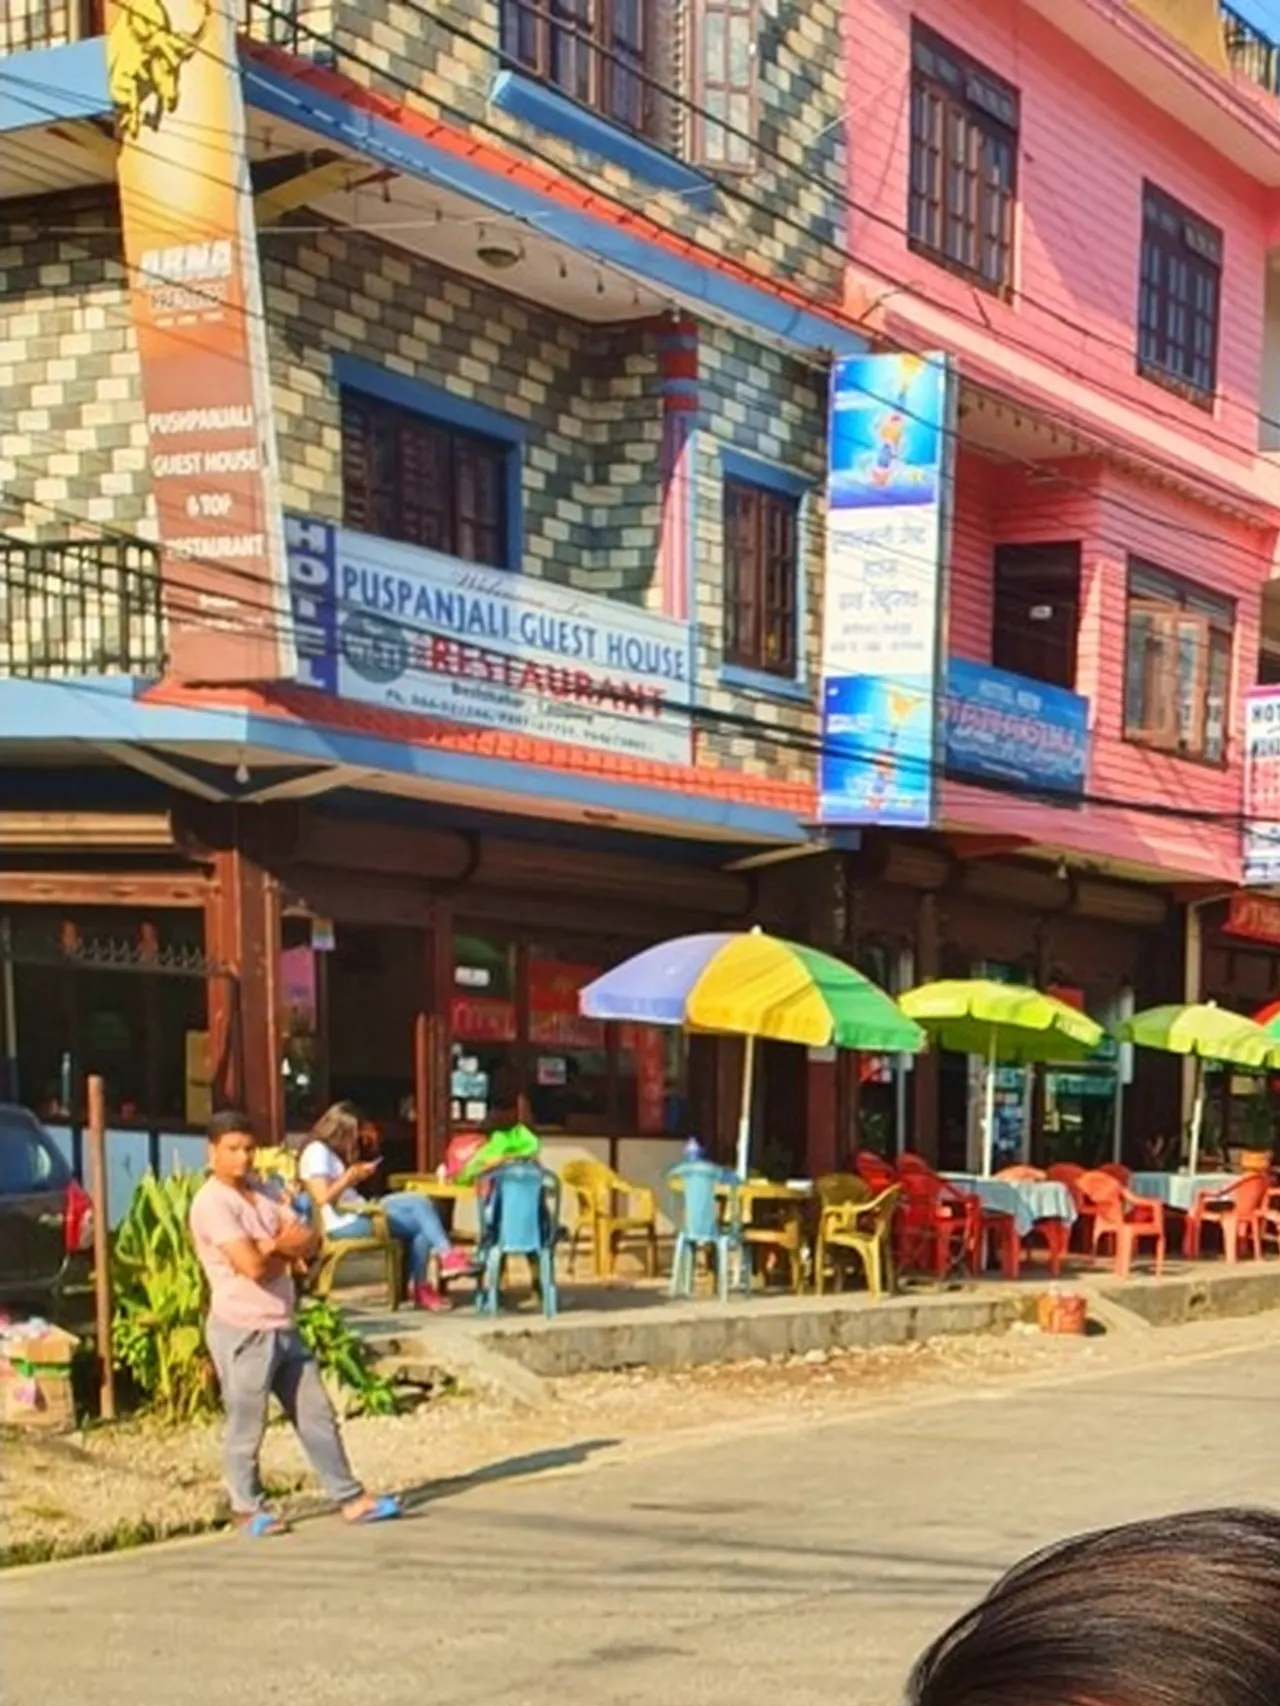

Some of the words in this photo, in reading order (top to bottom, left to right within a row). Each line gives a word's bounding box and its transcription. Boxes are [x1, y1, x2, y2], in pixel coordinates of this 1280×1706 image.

[153, 453, 201, 477] GUEST
[204, 449, 259, 473] HOUSE
[341, 563, 509, 640] PUSPANJALI
[520, 611, 598, 660] GUEST
[607, 631, 687, 681] HOUSE
[432, 636, 667, 717] RESTAURANT
